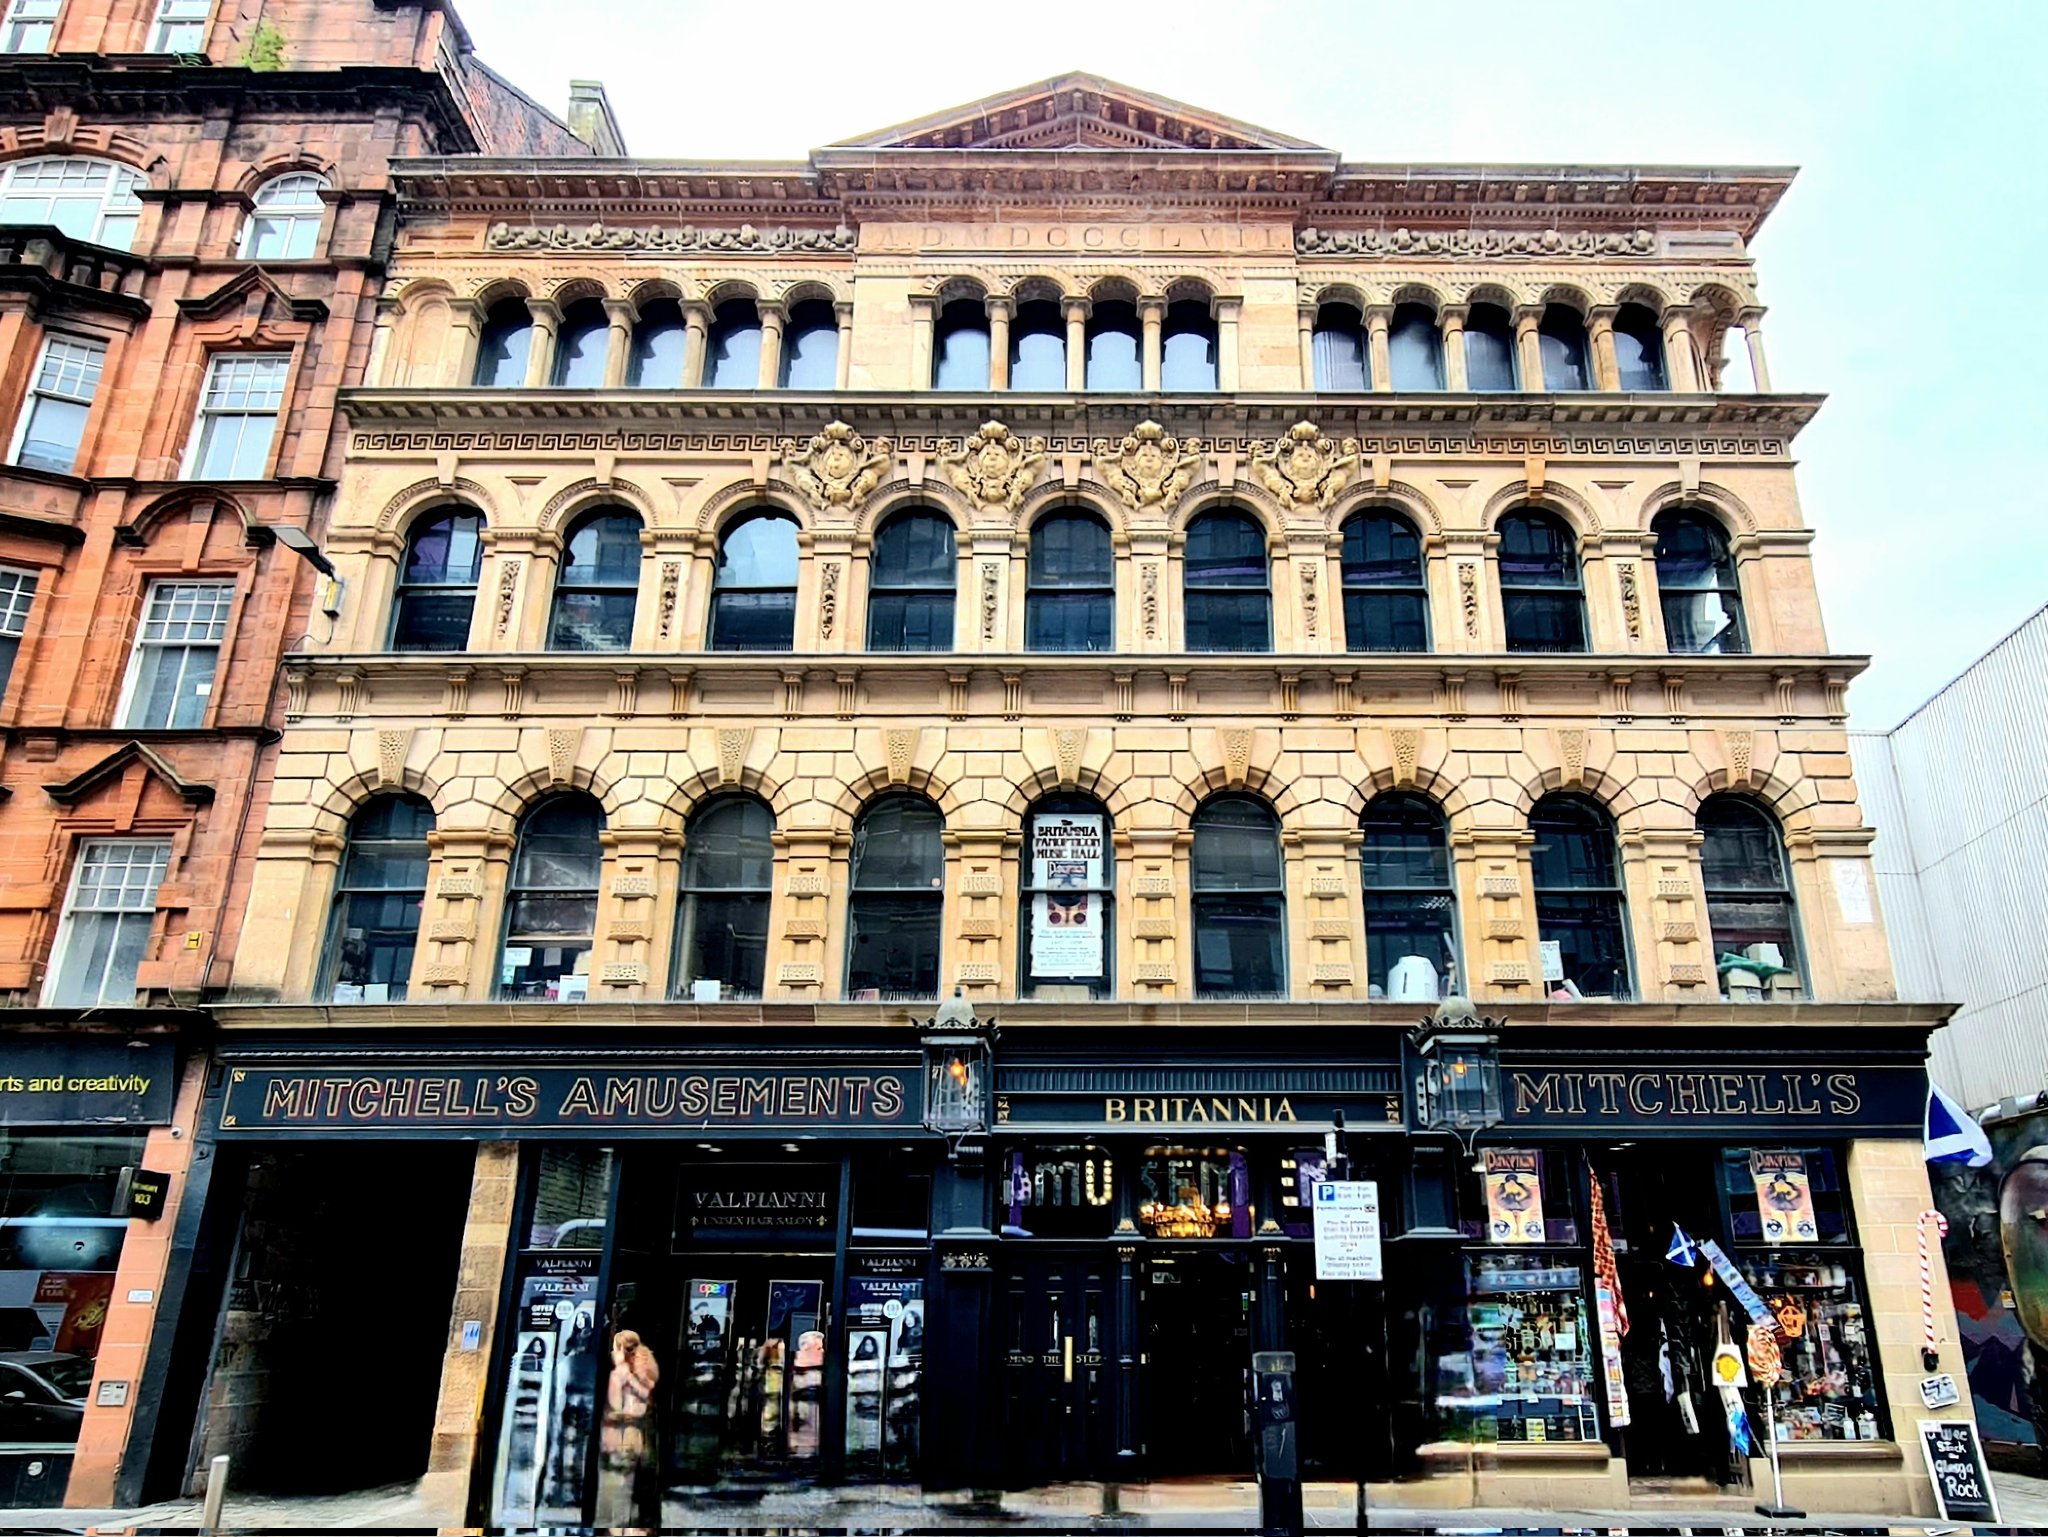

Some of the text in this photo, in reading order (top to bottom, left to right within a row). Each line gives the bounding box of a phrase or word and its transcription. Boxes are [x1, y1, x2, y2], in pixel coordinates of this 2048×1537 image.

[28, 1074, 65, 1092] and
[68, 1074, 152, 1096] creativity
[262, 1076, 905, 1117] MITCHELL'S AMUSEMENTS
[1513, 1073, 1861, 1115] MITCHELL'S
[1105, 1098, 1297, 1123] BRITANNIA
[692, 1191, 826, 1208] VALPIANNI
[699, 1283, 728, 1297] open
[1945, 1475, 1983, 1499] Rock
